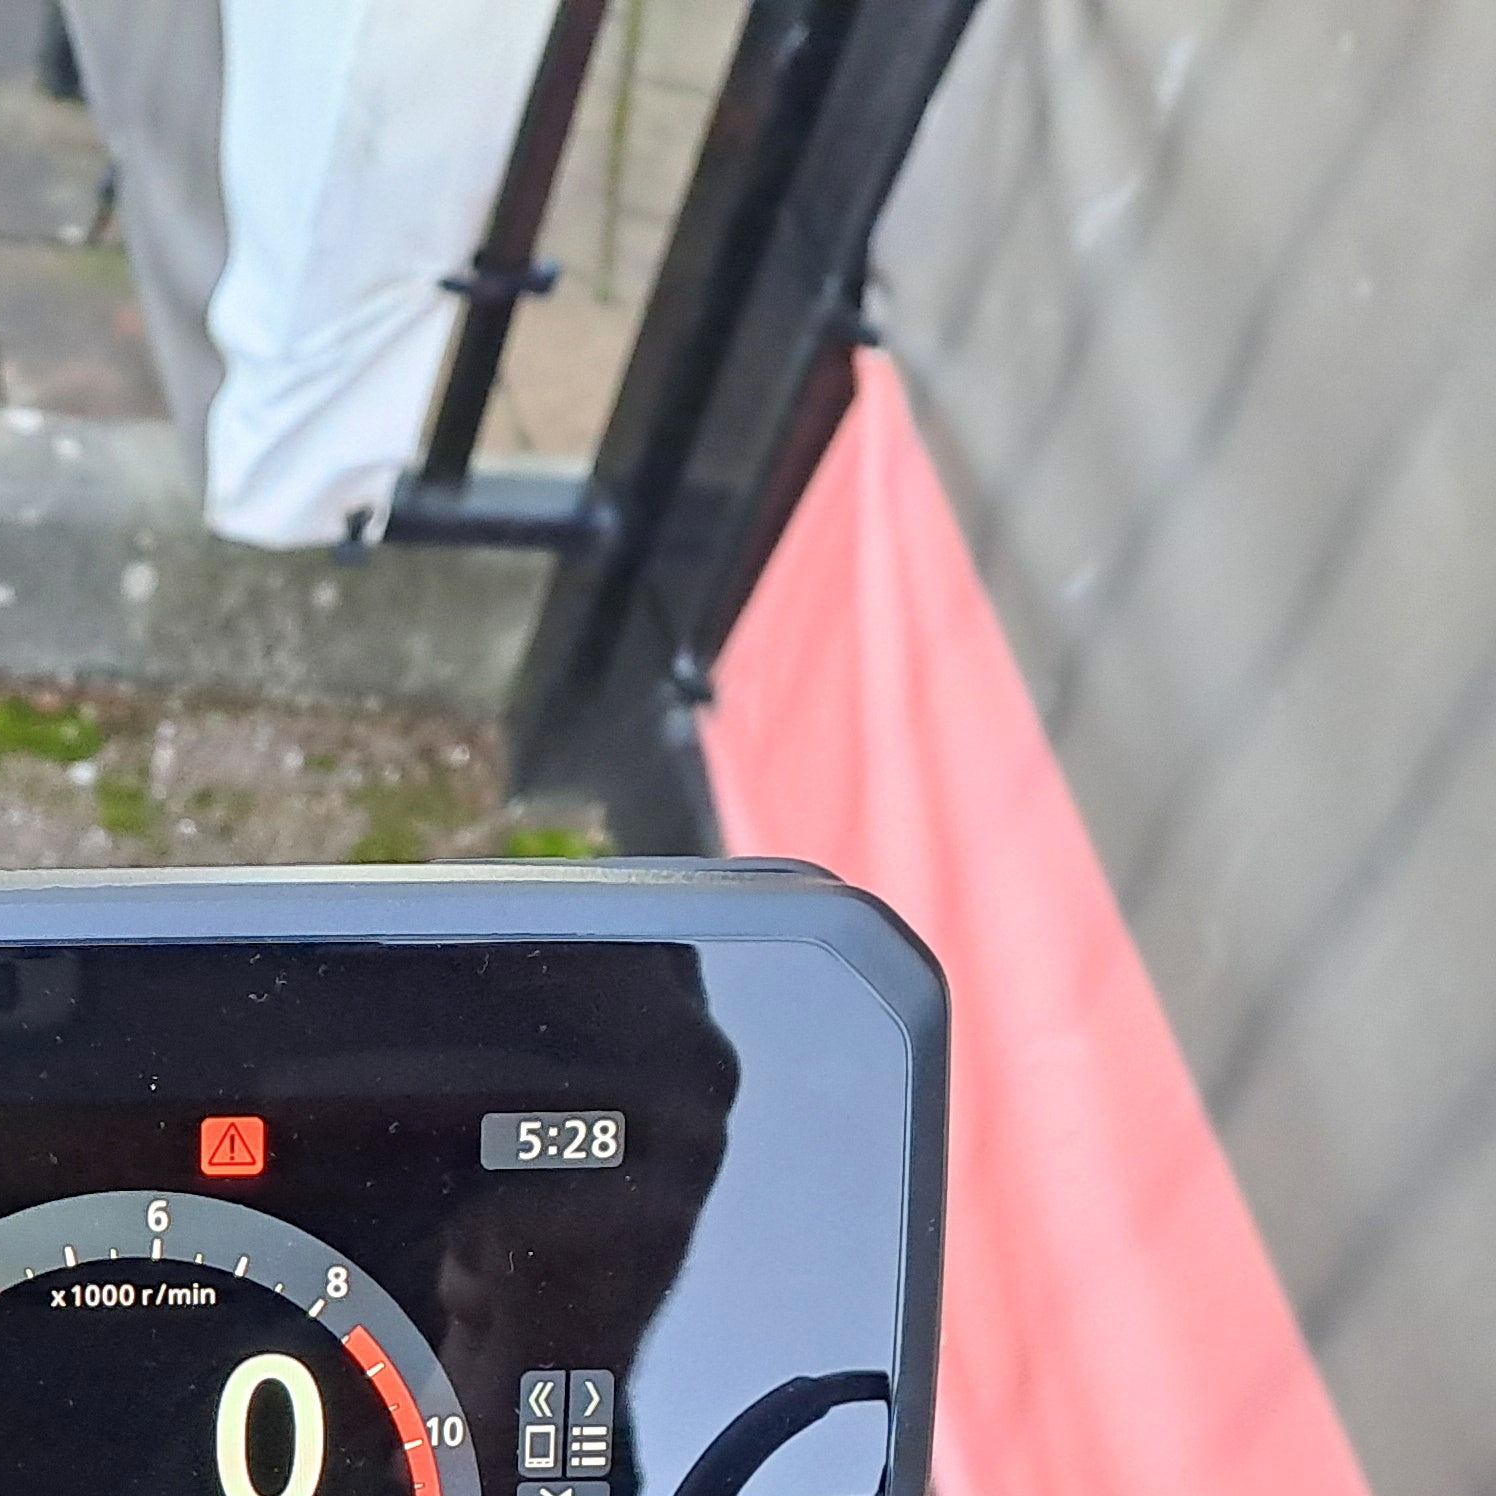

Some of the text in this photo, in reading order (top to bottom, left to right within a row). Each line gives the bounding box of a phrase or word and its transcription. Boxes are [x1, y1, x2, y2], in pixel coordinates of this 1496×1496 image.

[518, 1119, 618, 1160] 5:28
[147, 1200, 170, 1232] 6
[141, 1283, 217, 1306] r/min
[326, 1267, 349, 1299] 8
[426, 1416, 464, 1447] 10
